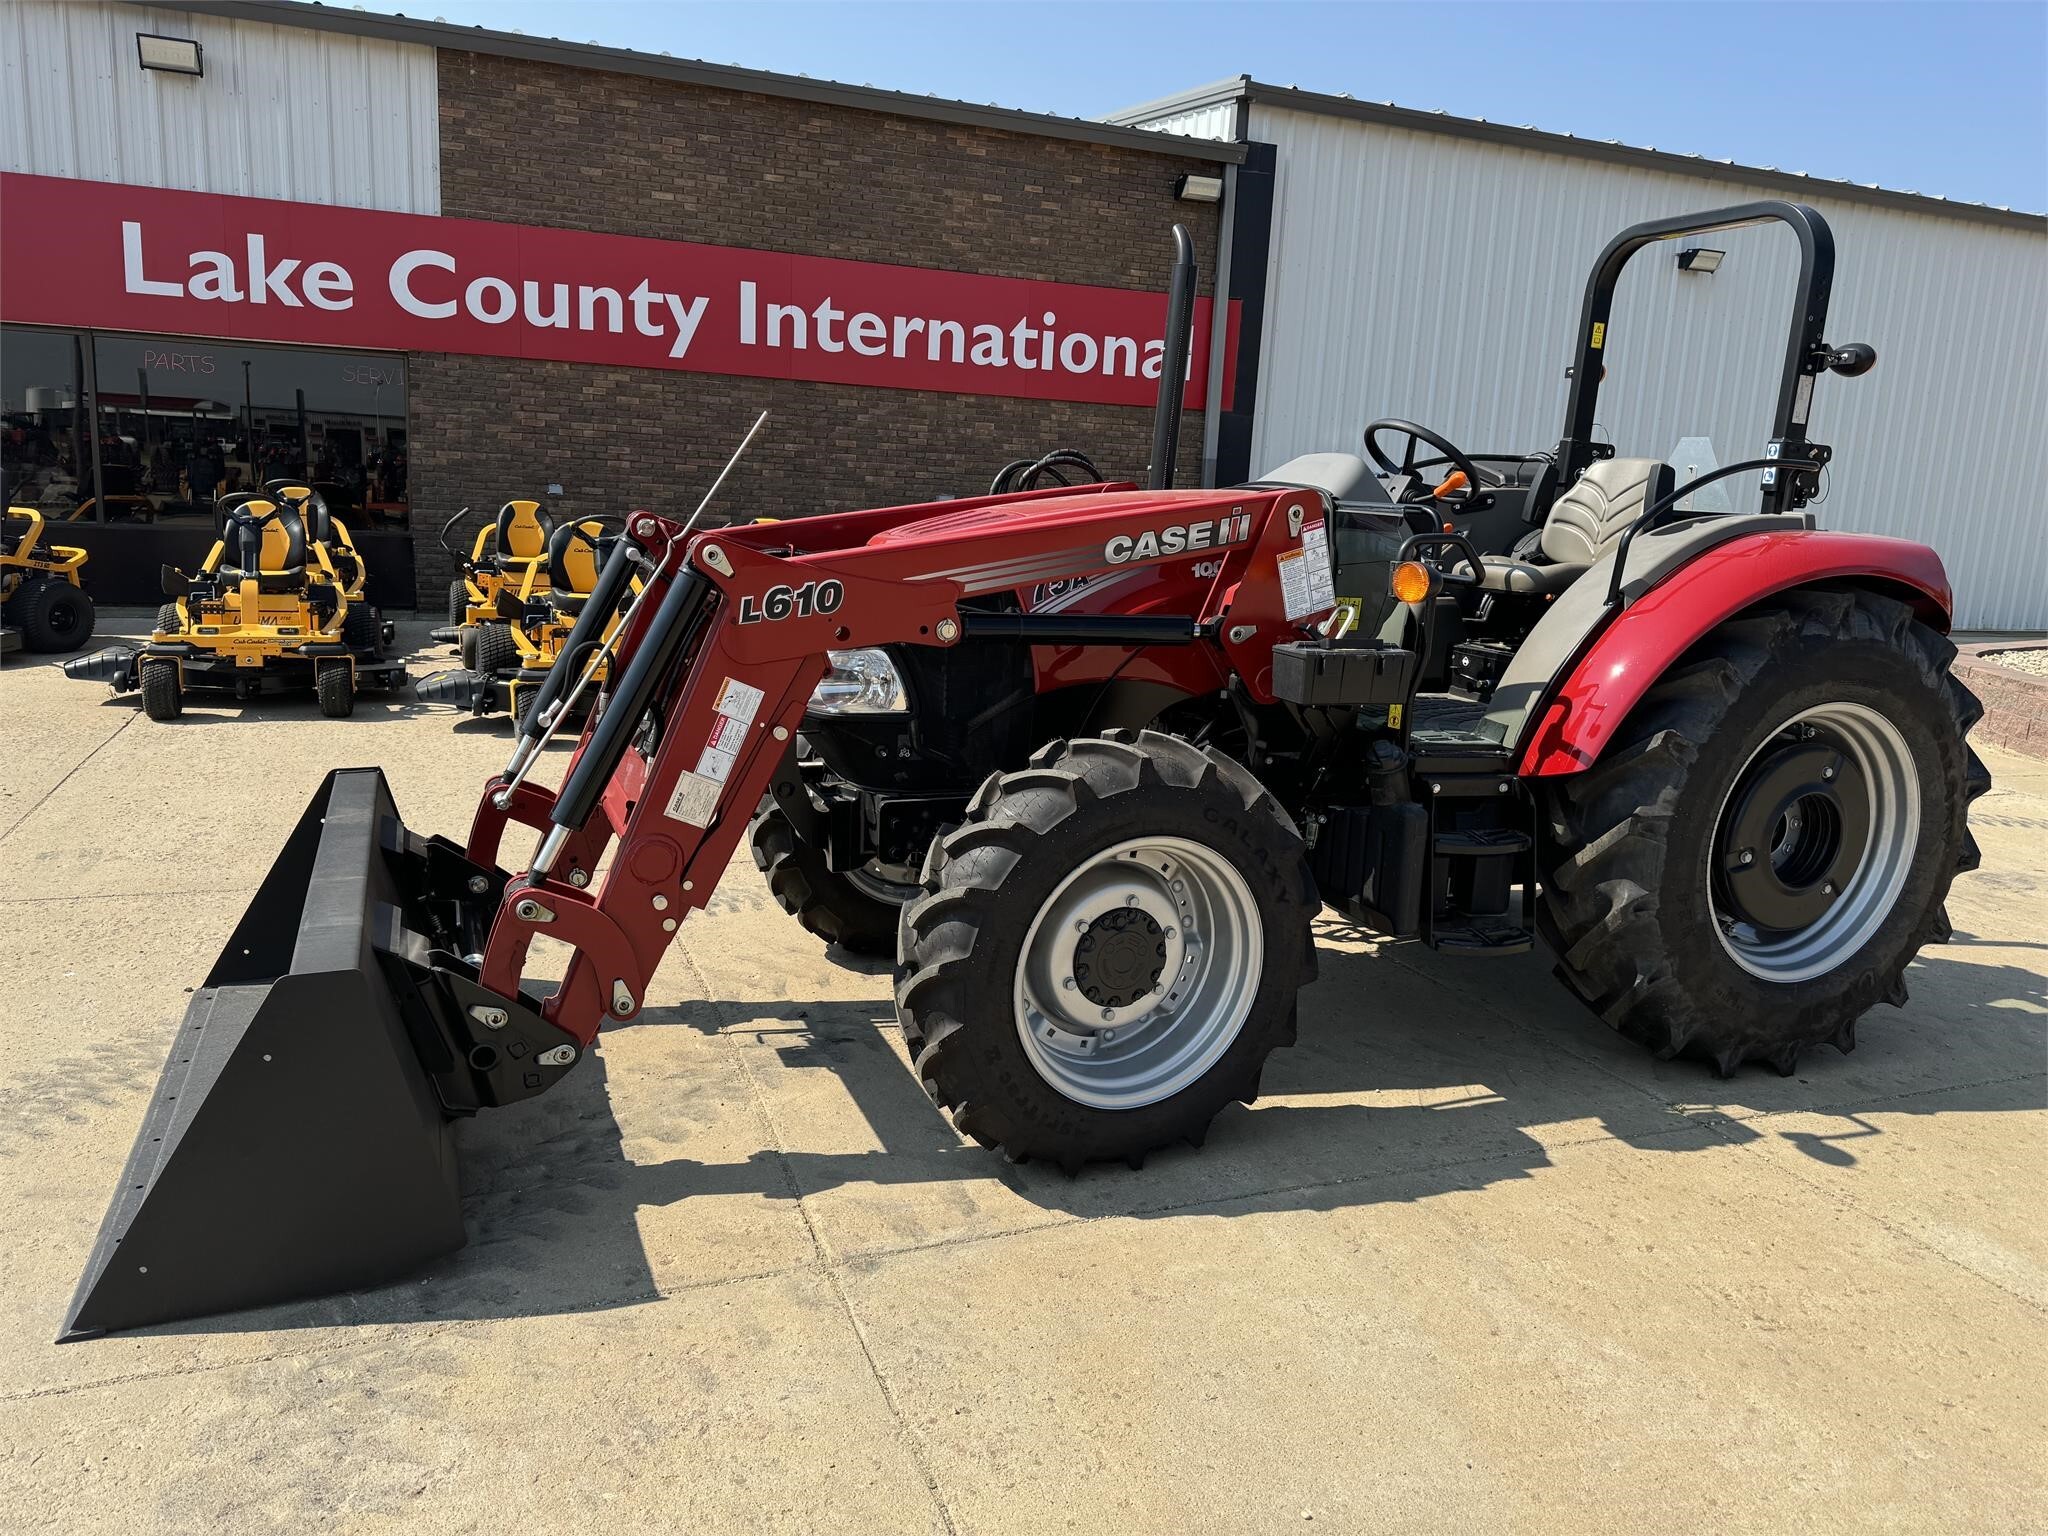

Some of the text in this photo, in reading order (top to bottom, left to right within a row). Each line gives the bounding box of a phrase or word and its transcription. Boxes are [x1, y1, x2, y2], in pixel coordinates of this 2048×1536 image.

[122, 221, 353, 311] Lake
[388, 249, 710, 359] County
[144, 350, 215, 374] PARTS
[1104, 520, 1213, 565] CASE
[738, 579, 844, 624] L610
[1203, 807, 1291, 903] GALAXY
